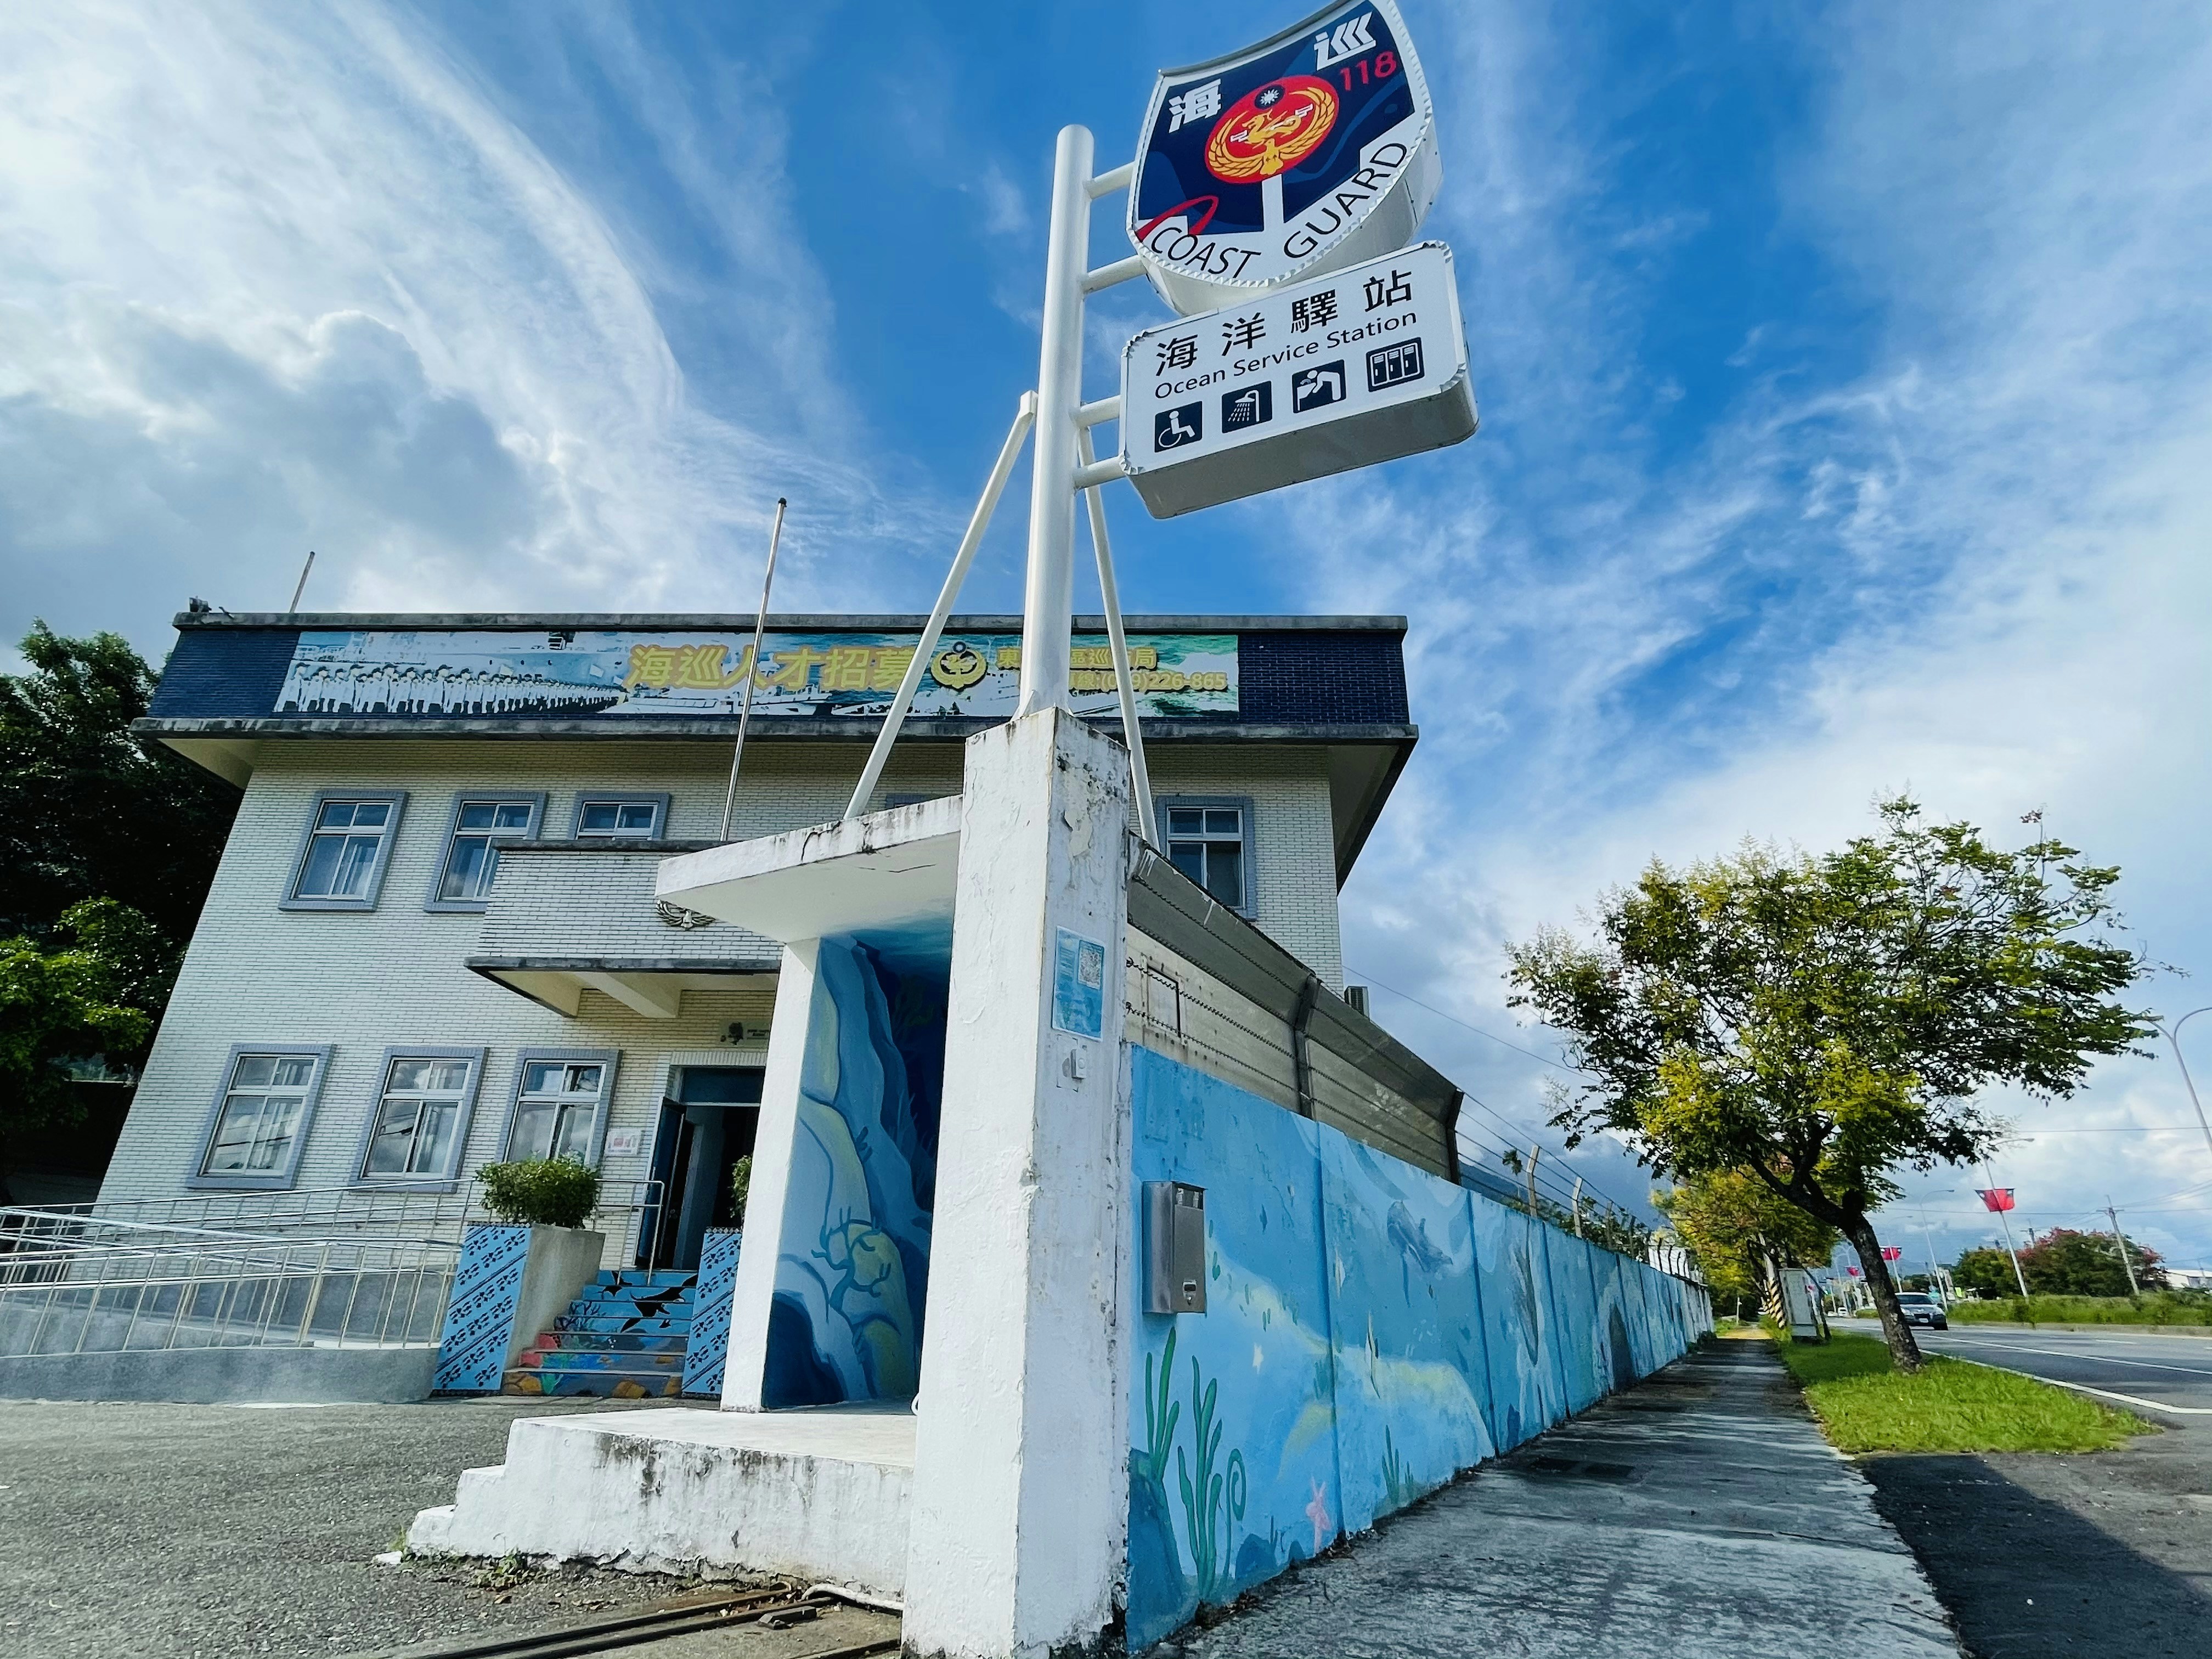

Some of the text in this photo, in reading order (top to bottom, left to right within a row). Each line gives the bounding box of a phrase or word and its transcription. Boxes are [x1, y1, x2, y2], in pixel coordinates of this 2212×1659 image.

[1340, 50, 1397, 91] 118
[1150, 142, 1408, 279] COAST GUARD
[1155, 269, 1413, 376] 海洋驛站
[1155, 312, 1417, 399] Ocean Service Station
